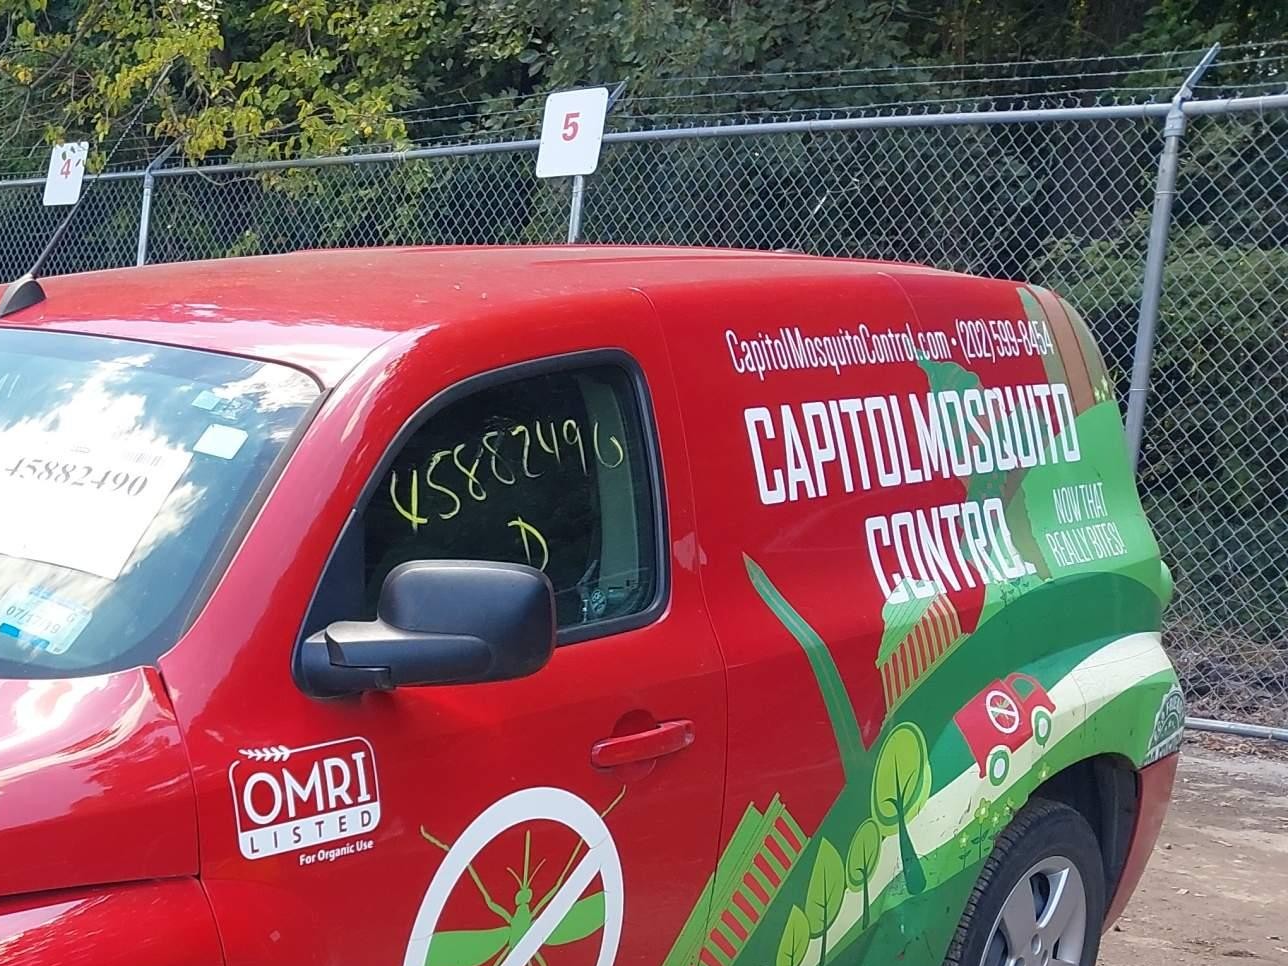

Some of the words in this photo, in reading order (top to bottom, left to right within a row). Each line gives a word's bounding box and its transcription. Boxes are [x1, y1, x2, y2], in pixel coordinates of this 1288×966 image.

[561, 111, 580, 142] 5
[60, 158, 72, 179] 4
[724, 322, 952, 380] CapitolMosquitoControl.com
[5, 457, 148, 496] 45882490
[390, 419, 624, 531] 45882490
[1053, 486, 1082, 524] NOW
[1079, 482, 1108, 519] THAT
[864, 498, 1037, 604] CONTRO
[1045, 528, 1094, 567] REALLY
[1086, 521, 1128, 559] BITES!
[243, 751, 370, 825] OMRI
[250, 811, 372, 854] LISTED
[299, 853, 317, 866] For
[317, 843, 355, 862] Organic
[356, 839, 374, 852] Use
